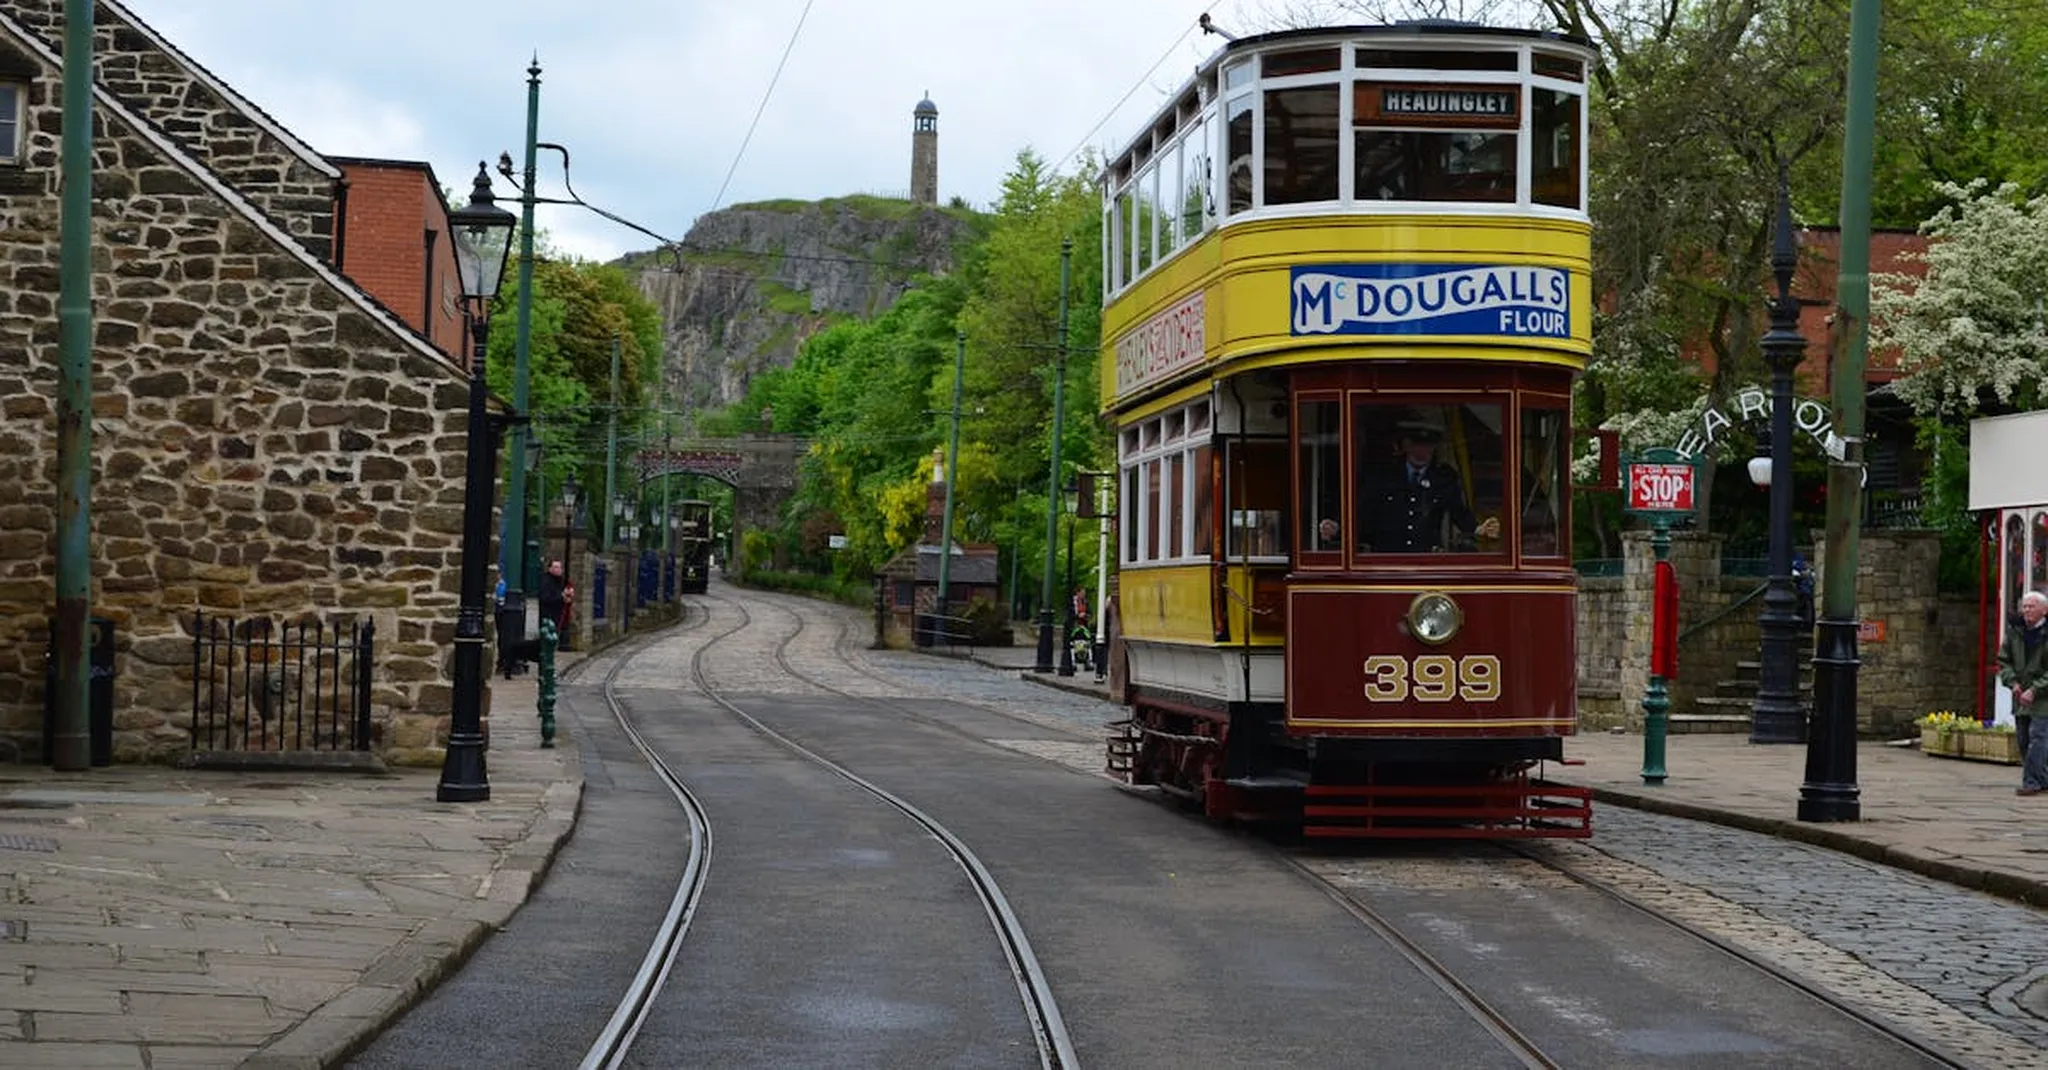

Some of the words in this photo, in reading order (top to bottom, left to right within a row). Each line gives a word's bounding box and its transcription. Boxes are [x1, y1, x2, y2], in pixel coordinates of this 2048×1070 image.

[1386, 91, 1508, 112] HEADINGLEY
[1500, 310, 1566, 335] FLOUR
[1640, 474, 1684, 501] STOP
[1363, 654, 1501, 702] 399
